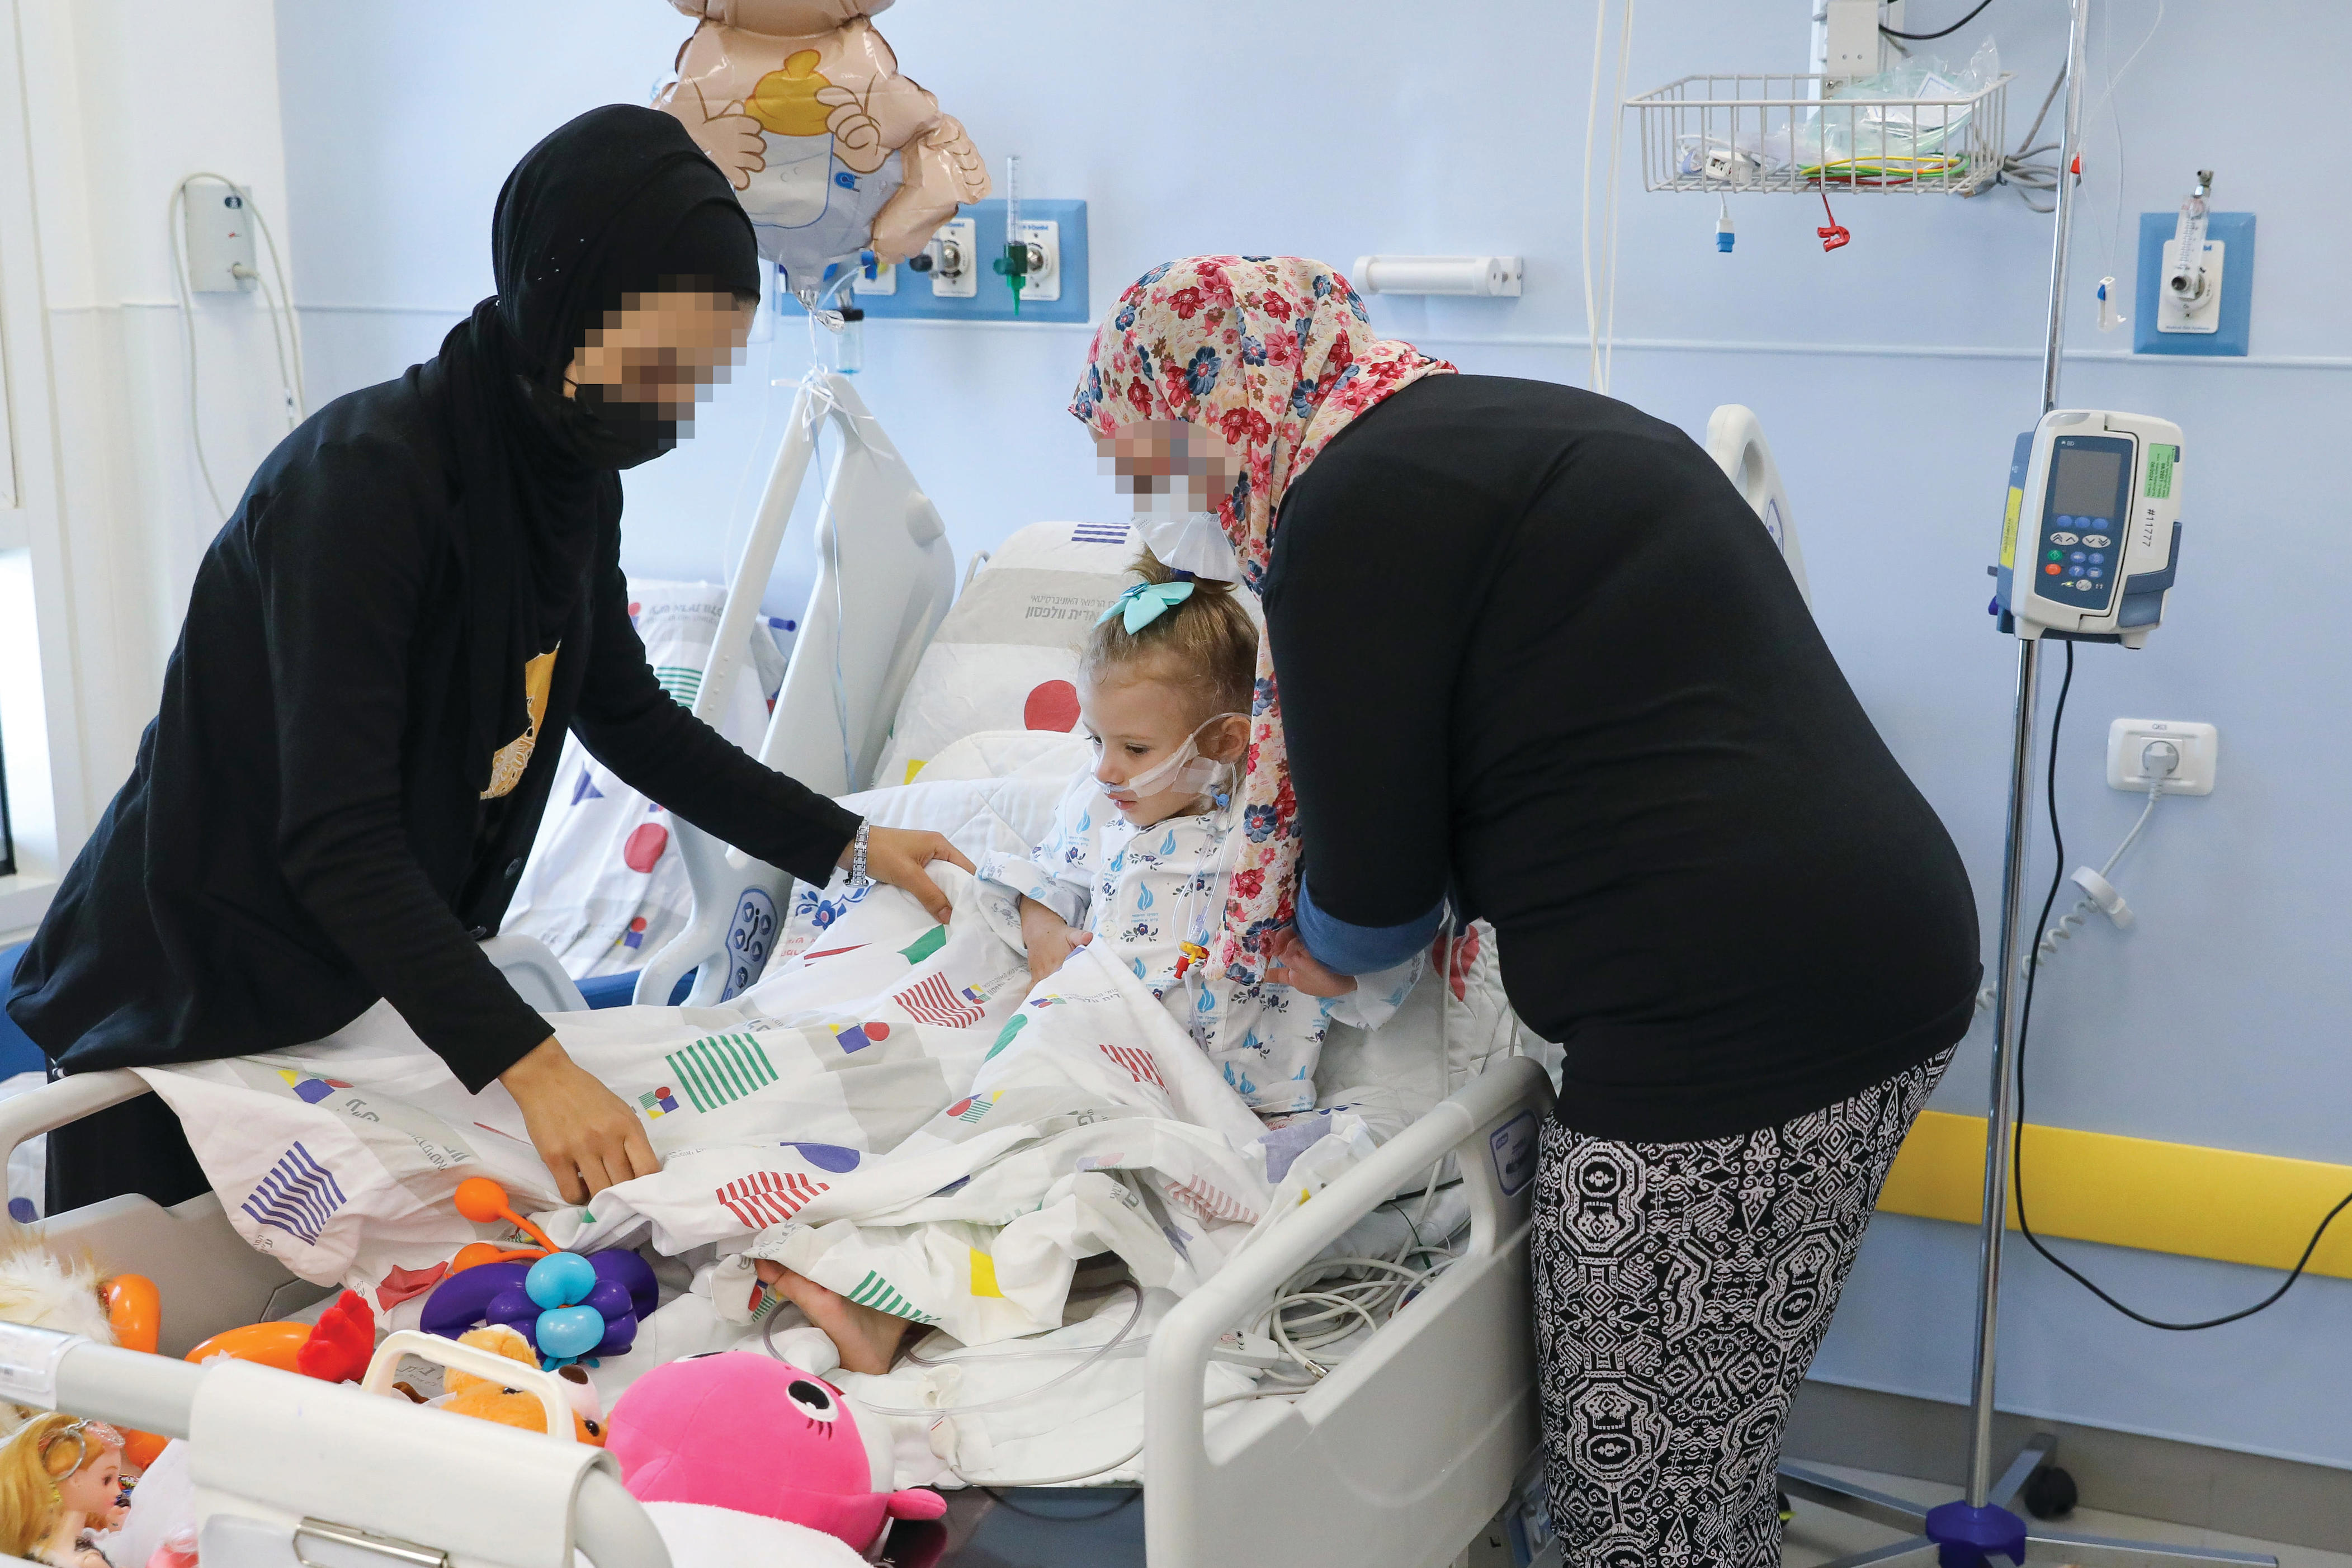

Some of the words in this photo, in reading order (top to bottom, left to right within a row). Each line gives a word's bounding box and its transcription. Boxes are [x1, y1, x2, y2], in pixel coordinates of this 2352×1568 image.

[2142, 509, 2156, 547] #11777
[1080, 598, 1106, 608] הרפואי
[1025, 606, 1066, 620] וולפסון
